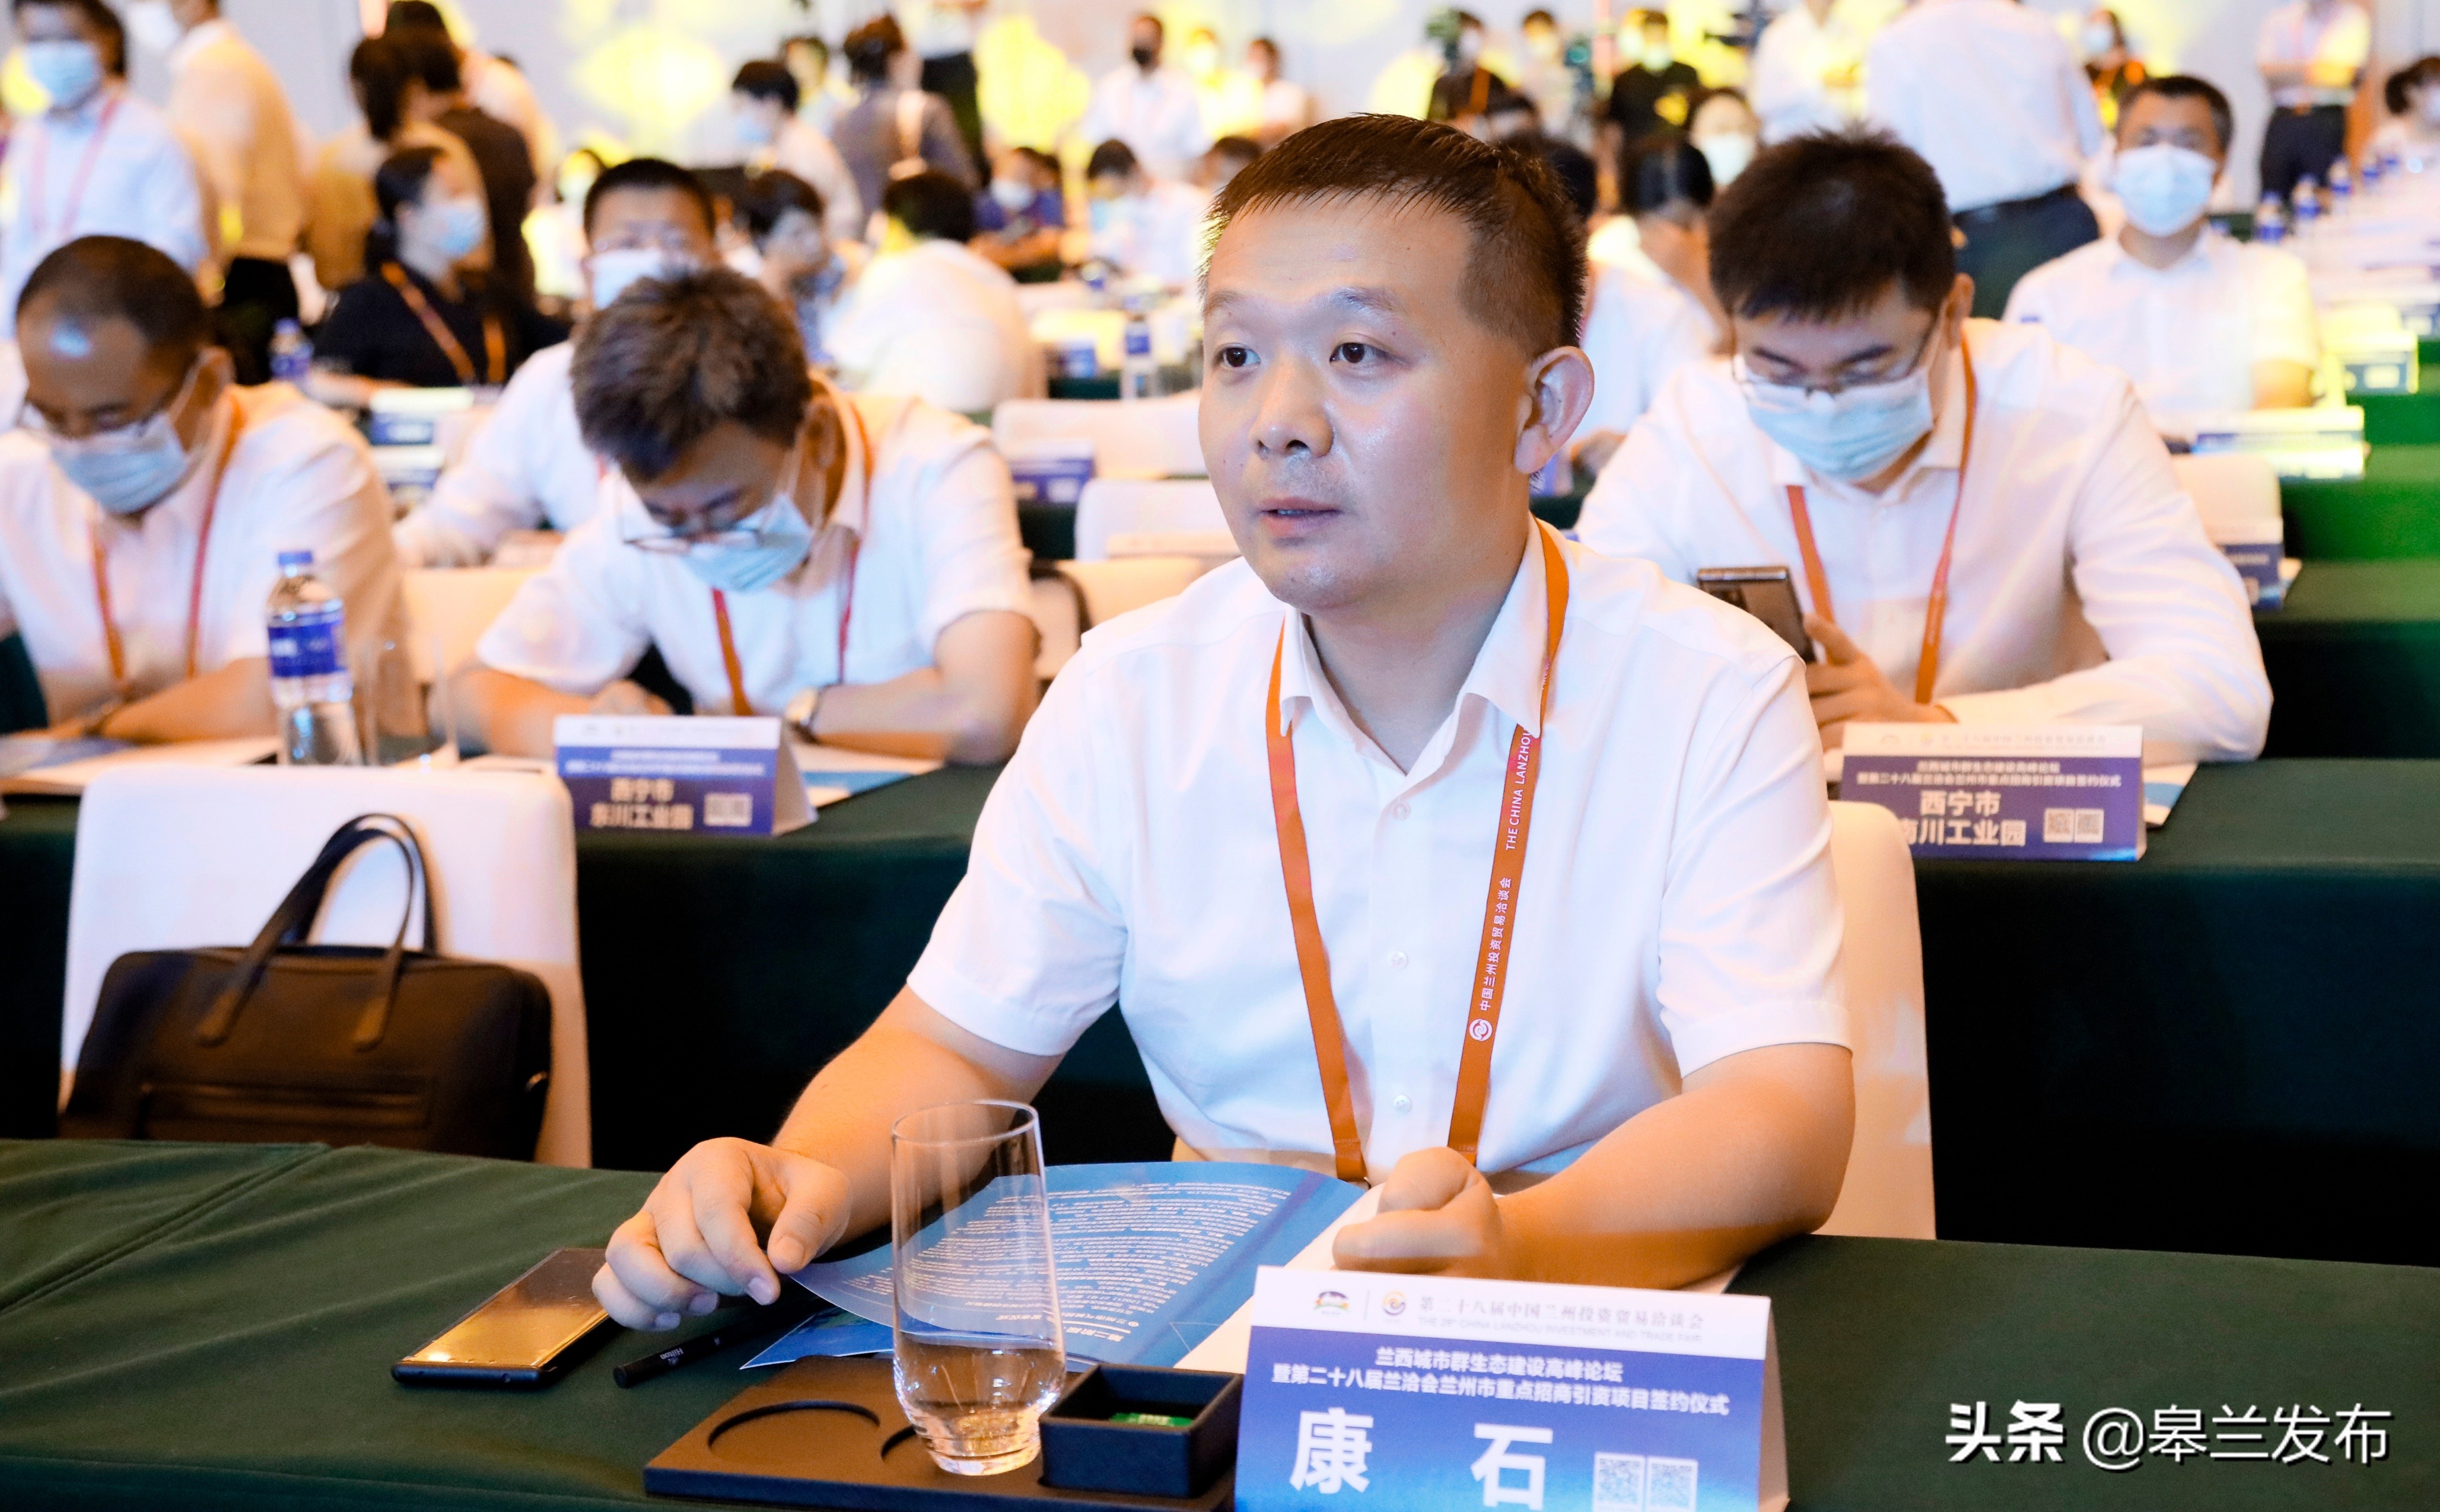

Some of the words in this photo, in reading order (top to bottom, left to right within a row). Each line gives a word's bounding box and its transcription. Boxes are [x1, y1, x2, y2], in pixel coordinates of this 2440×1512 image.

[1510, 790, 1523, 826] CHINA
[1920, 790, 2002, 817] 西宁市
[1506, 827, 1518, 850] THE
[1480, 877, 1512, 1011] 中国兰州投资贸易洽谈会
[1418, 1317, 1437, 1326] THE
[1460, 1319, 1491, 1329] CHINA
[1494, 1320, 1543, 1332] LANZHOU
[1546, 1325, 1611, 1338] INVESTMENT
[1615, 1329, 1637, 1339] AND
[1641, 1331, 1674, 1341] TRADE
[1420, 1296, 1704, 1329] 第二十八届中国兰州投资贸易洽谈会
[660, 1348, 683, 1360] Hilton
[1376, 1346, 1623, 1383] 兰西城市群生态建设高峰论坛
[1271, 1363, 1730, 1415] 暨第二十八届兰洽会兰州市重点招商引资项目签约仪式
[1289, 1407, 1374, 1494] 康
[1471, 1423, 1554, 1511] 石
